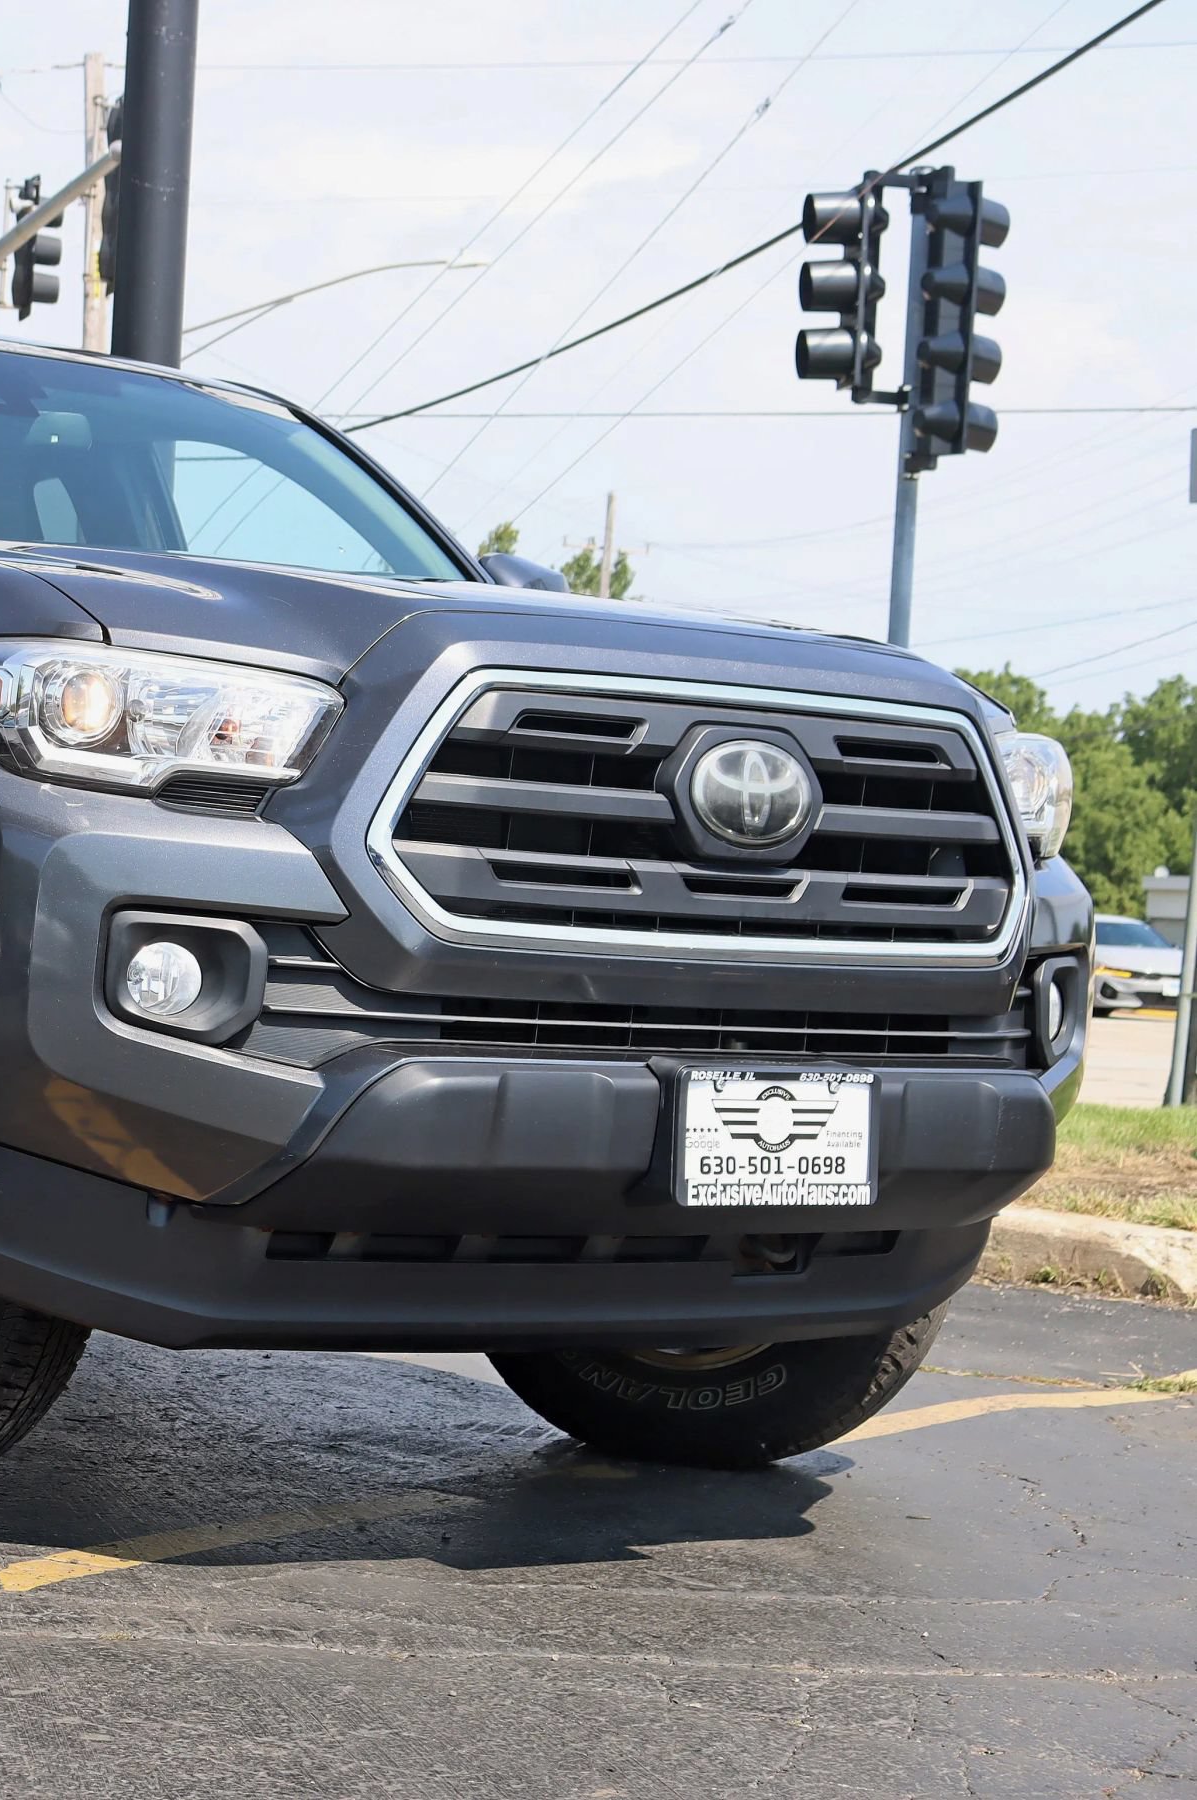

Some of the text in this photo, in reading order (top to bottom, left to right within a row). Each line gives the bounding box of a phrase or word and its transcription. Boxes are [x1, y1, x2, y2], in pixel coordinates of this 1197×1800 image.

[744, 1071, 756, 1081] IL
[799, 1072, 875, 1084] 630-501-0698
[761, 1087, 792, 1101] EXCLUSIVE
[826, 1130, 863, 1140] Financing
[685, 1136, 721, 1152] Google
[757, 1138, 791, 1152] AUTOHAUS
[826, 1140, 861, 1149] Available
[700, 1155, 846, 1176] 630-501-0698
[687, 1178, 871, 1207] ExclusiveAutoHaus.com
